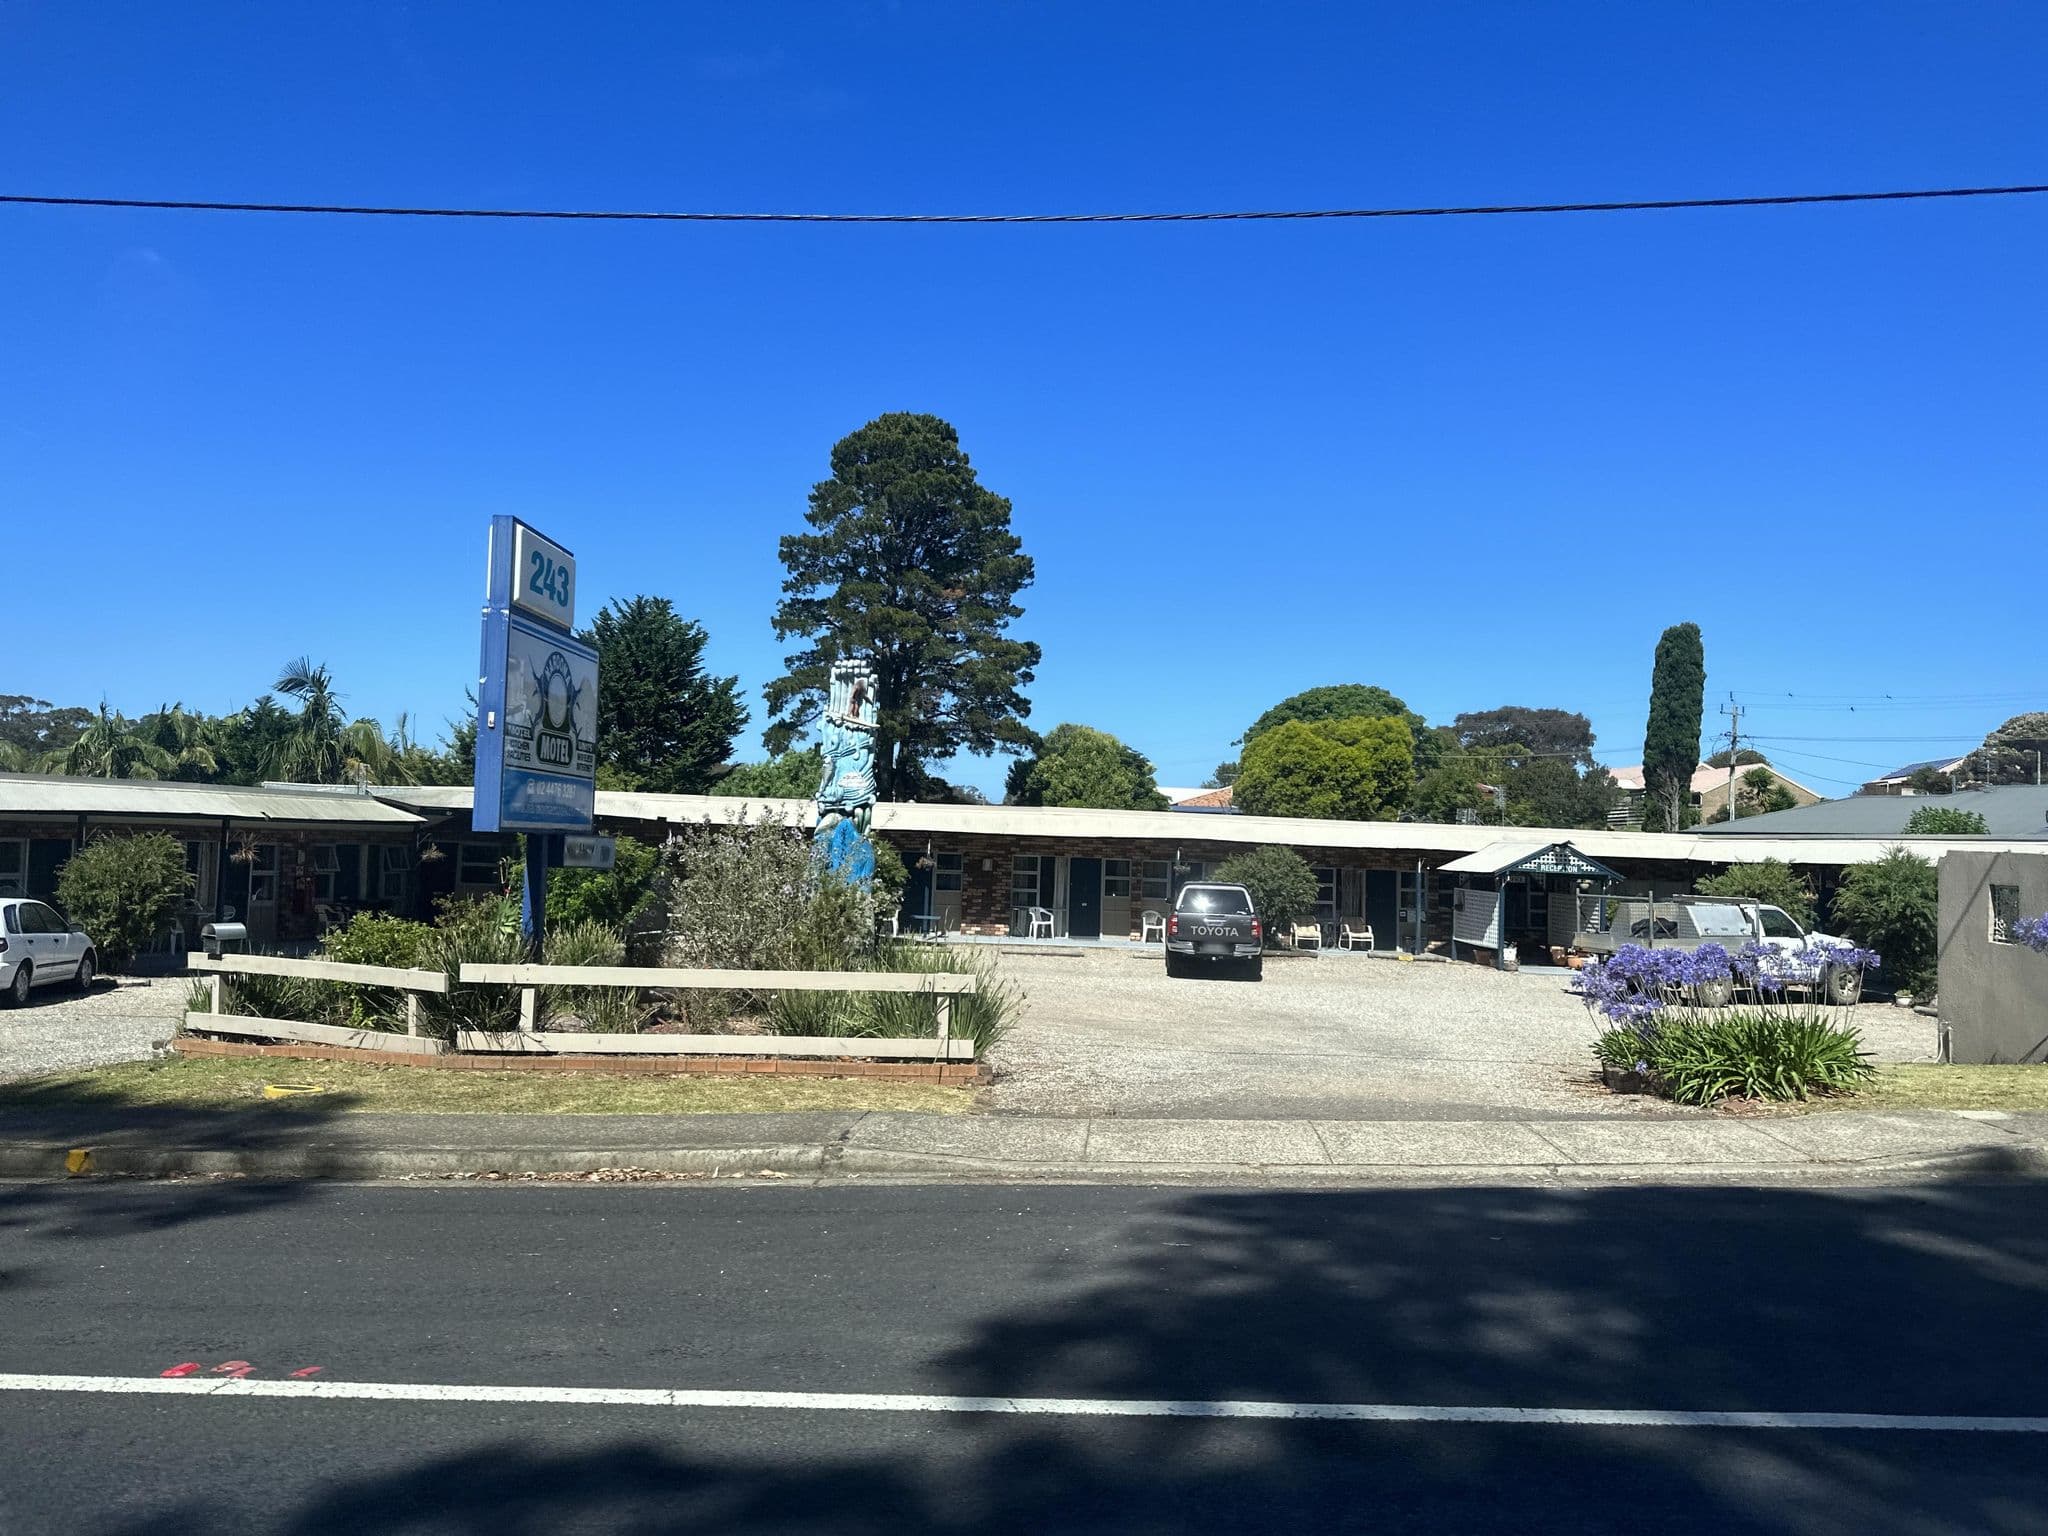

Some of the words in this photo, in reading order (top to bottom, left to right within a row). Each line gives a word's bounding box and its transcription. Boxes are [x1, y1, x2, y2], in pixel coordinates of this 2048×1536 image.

[530, 550, 569, 607] 243
[508, 725, 531, 738] MOTEL
[540, 735, 570, 763] MOTEL
[536, 781, 545, 795] 02
[1540, 864, 1578, 873] RECEPON
[1190, 926, 1239, 937] TOYOTA
